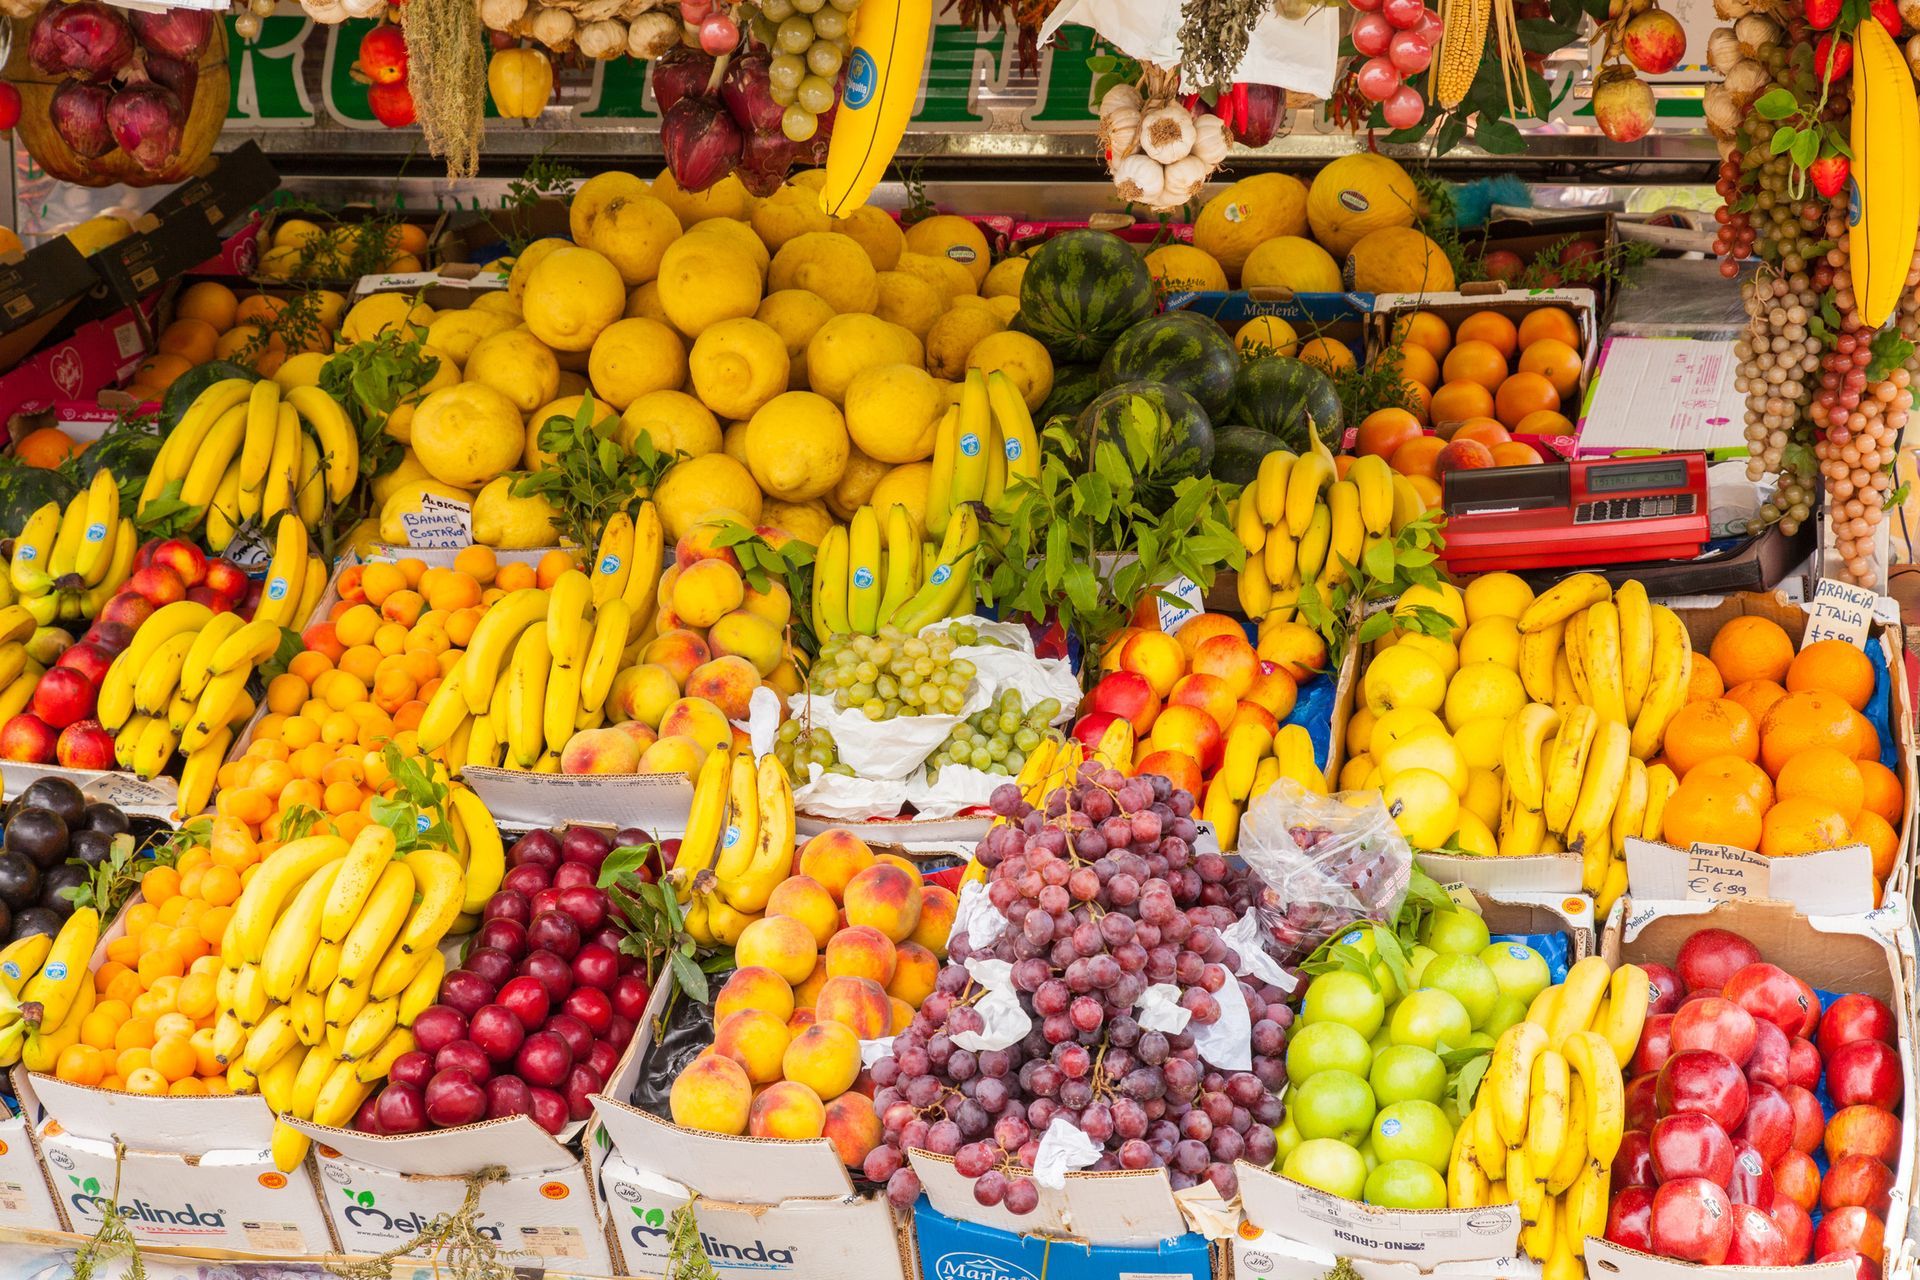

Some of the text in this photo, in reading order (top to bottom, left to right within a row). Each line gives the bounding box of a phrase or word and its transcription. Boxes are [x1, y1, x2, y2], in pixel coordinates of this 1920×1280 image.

[1243, 303, 1299, 317] Marlene
[1689, 858, 1744, 877] ITALIA
[631, 1225, 795, 1264] Mlinda
